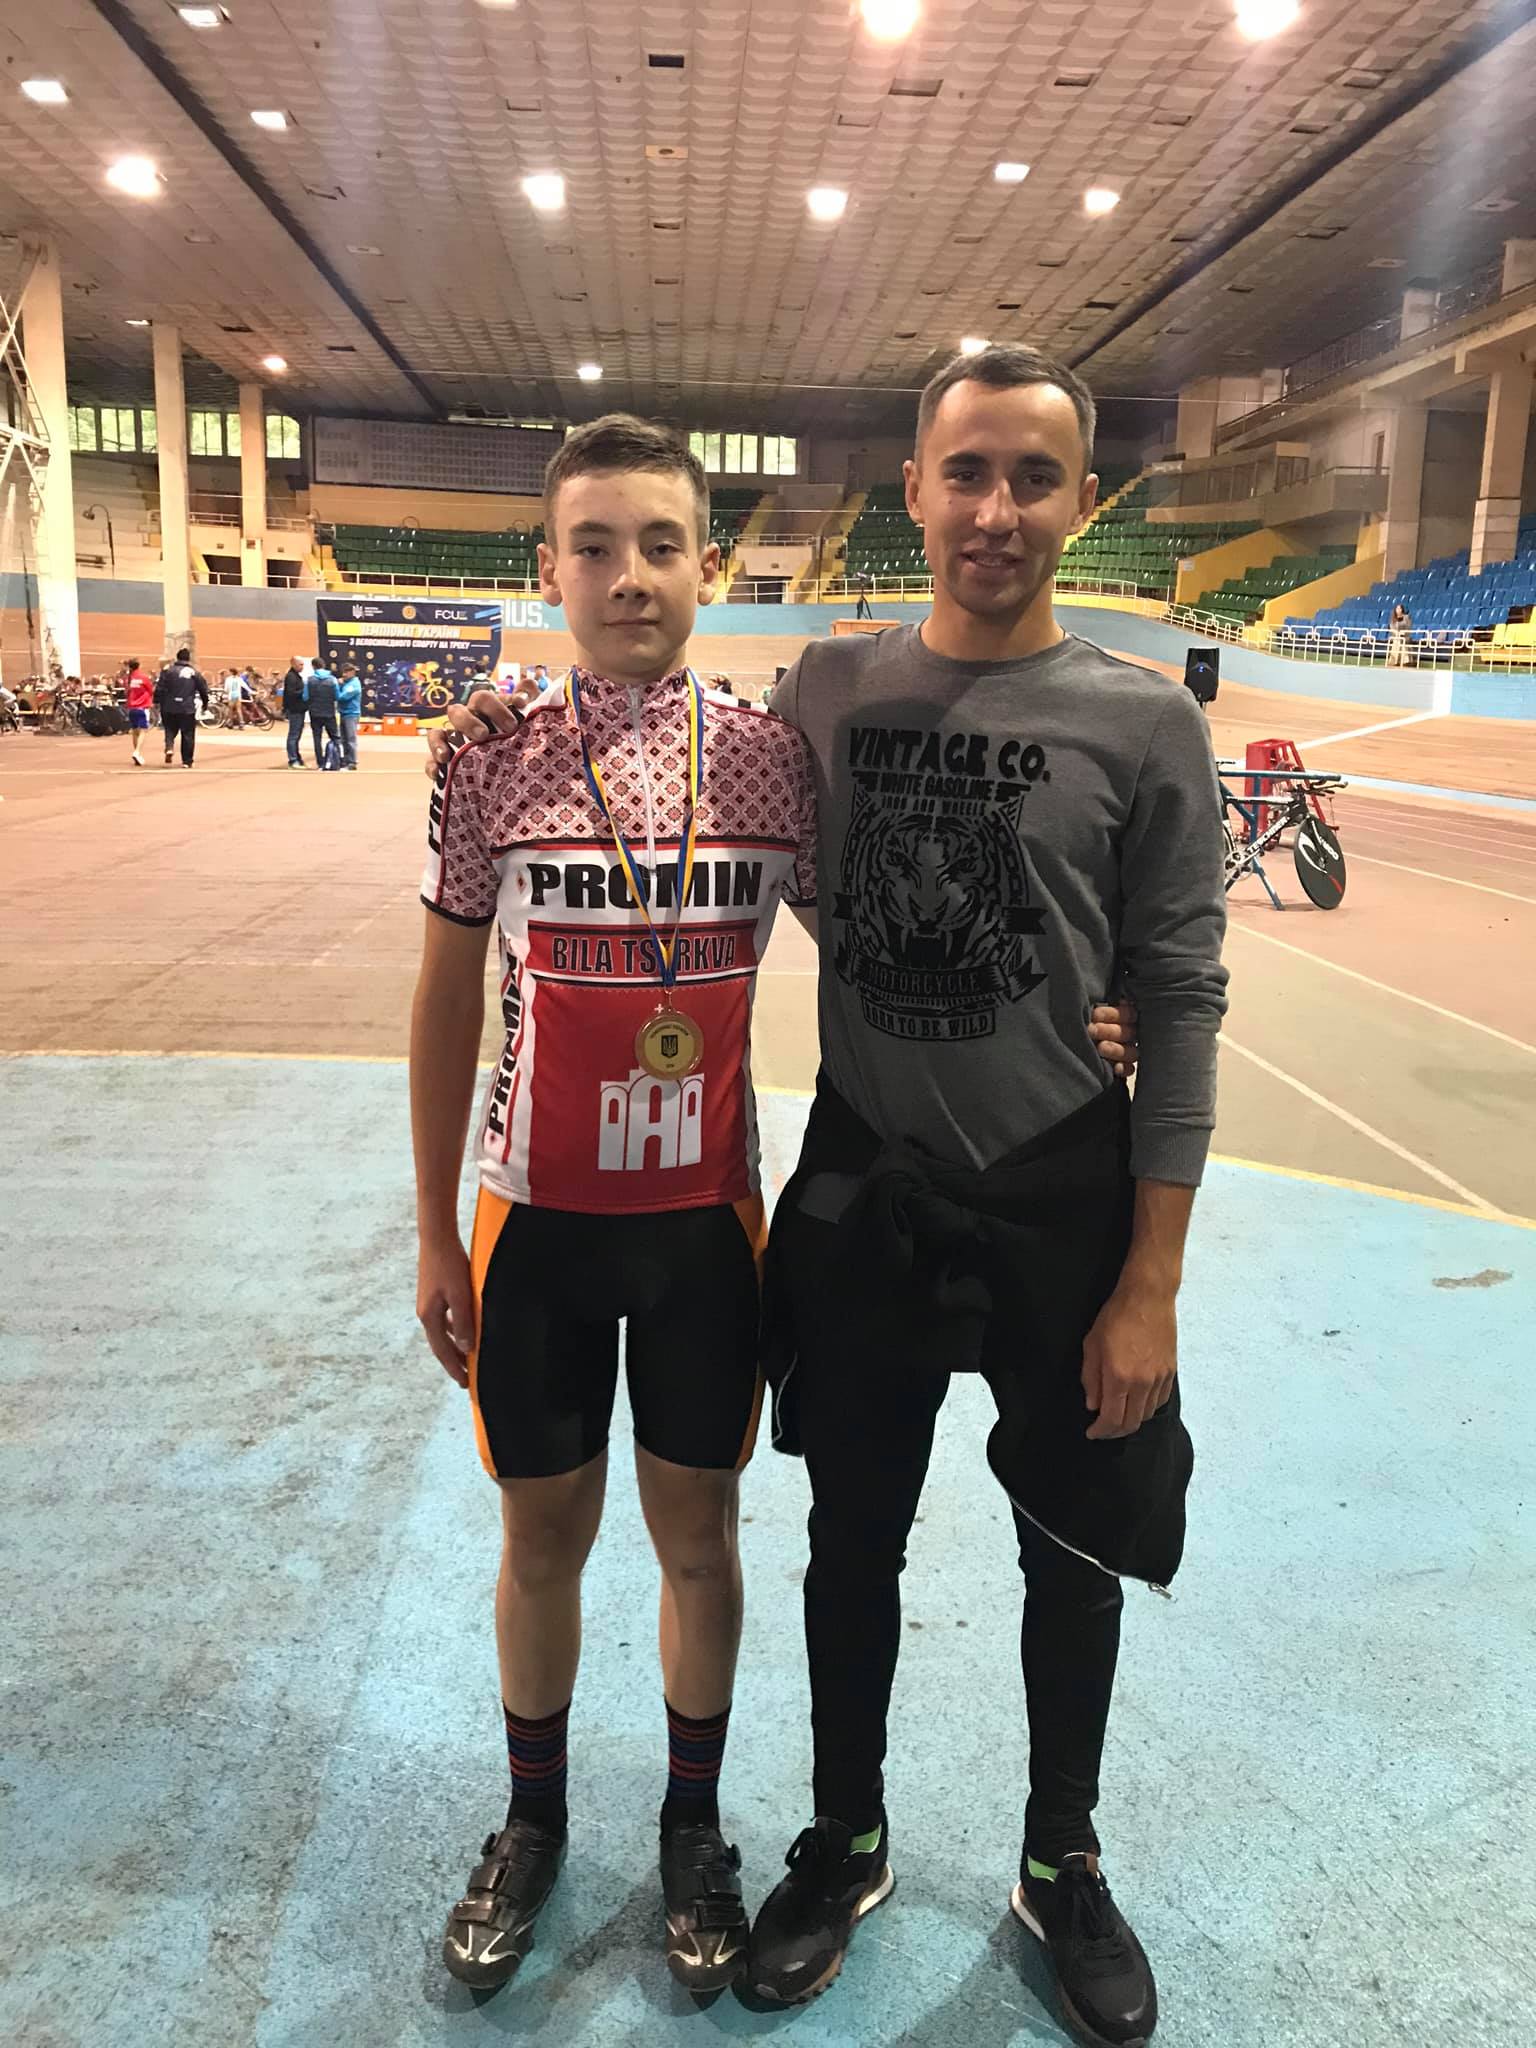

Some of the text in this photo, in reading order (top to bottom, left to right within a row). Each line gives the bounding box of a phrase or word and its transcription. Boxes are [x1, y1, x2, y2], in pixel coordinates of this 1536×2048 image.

[848, 727, 1050, 783] VINTAGE CO.
[526, 861, 763, 909] PROMIN
[552, 934, 736, 975] BILA TSRKVA
[868, 962, 980, 997] MOTORCYCLE
[898, 1015, 916, 1036] TO
[921, 1019, 941, 1037] BE
[948, 1014, 989, 1037] WILD
